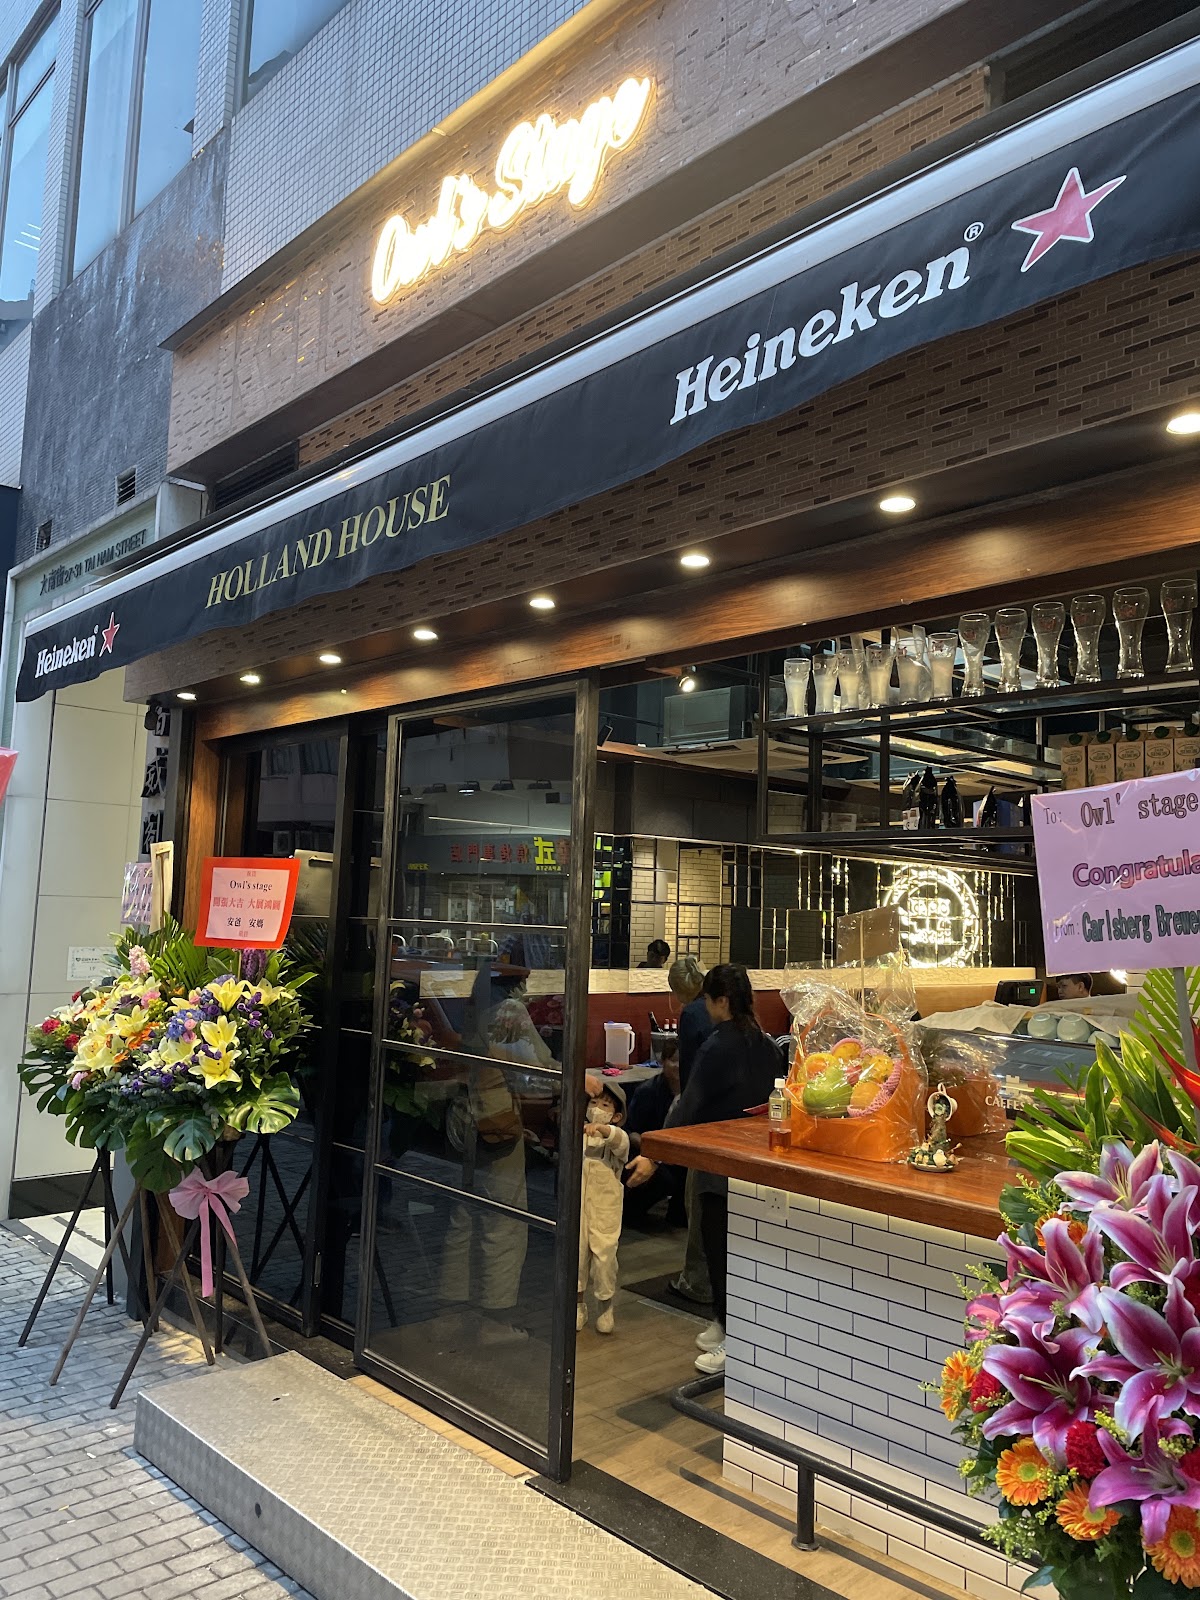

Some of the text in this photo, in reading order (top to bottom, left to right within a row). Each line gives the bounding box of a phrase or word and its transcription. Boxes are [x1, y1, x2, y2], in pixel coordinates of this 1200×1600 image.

[669, 246, 971, 426] Heineken
[84, 555, 96, 573] TAI
[96, 545, 115, 568] NAM
[115, 528, 147, 559] STREET
[204, 473, 451, 609] HOLLAND HOUSE
[34, 634, 97, 679] Heineken
[1044, 806, 1062, 825] To:
[1137, 792, 1199, 820] stage
[229, 879, 273, 893] Owl's stage
[1081, 908, 1153, 944] Carlsberg
